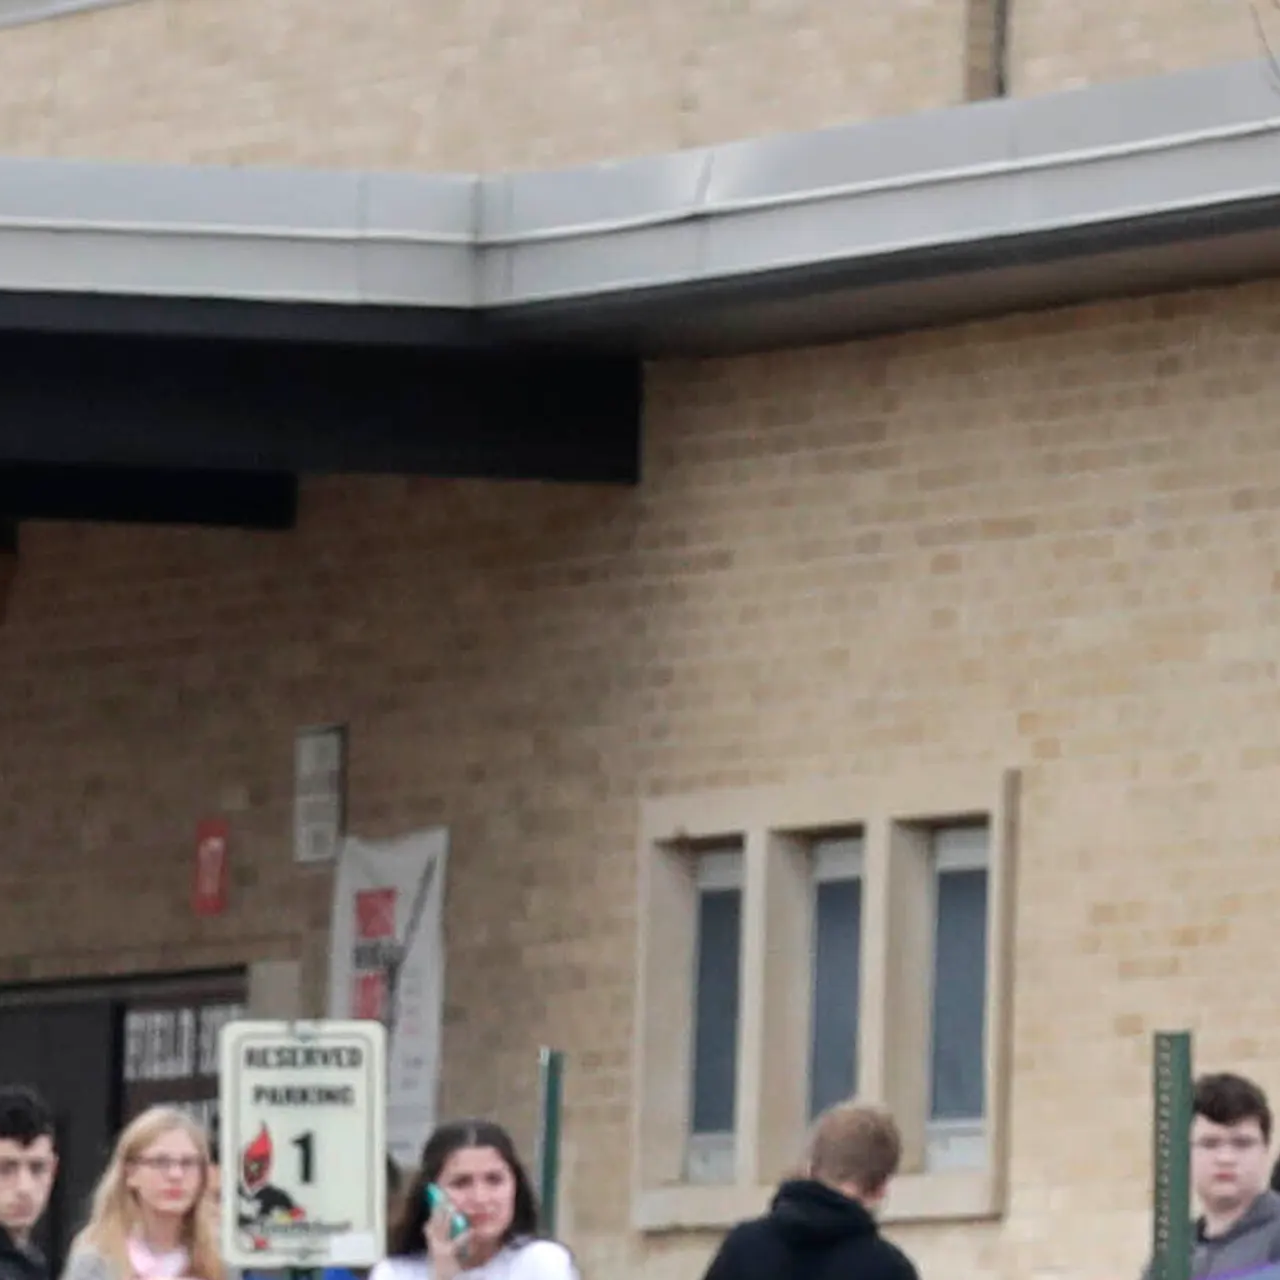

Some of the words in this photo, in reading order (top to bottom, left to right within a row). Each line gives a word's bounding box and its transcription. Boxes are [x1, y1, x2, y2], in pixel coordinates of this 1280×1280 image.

[244, 1046, 363, 1070] RESERVED
[253, 1084, 355, 1106] PARKING
[290, 1132, 314, 1184] 1
